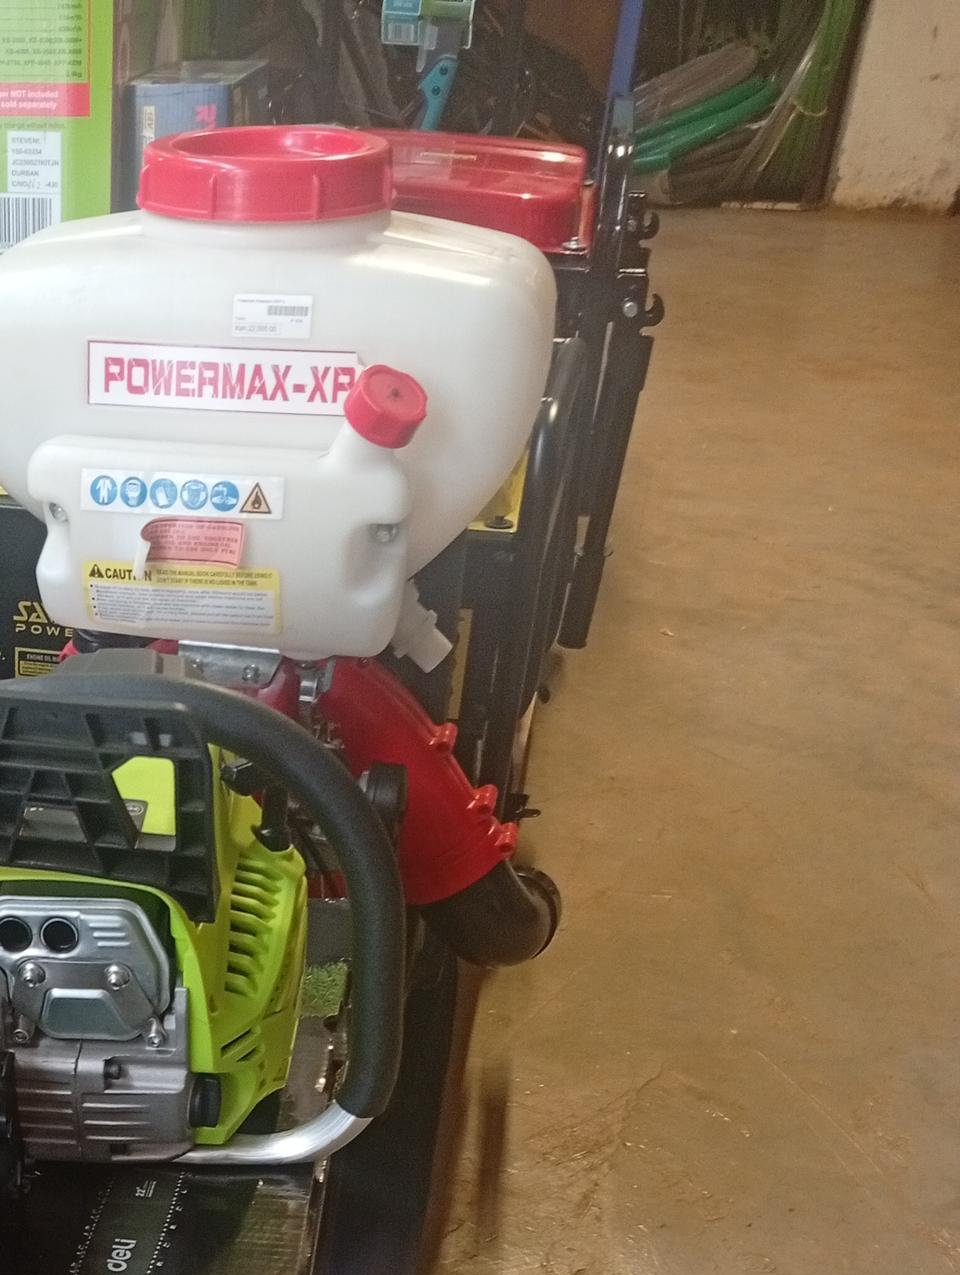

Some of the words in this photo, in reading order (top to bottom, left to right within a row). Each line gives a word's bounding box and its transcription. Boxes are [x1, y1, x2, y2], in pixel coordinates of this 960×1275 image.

[11, 90, 27, 98] NOT
[28, 90, 59, 99] included
[1, 100, 17, 108] sold
[19, 100, 58, 110] separately
[105, 568, 152, 582] CAUTN
[15, 623, 74, 638] POWE
[106, 1238, 137, 1272] deli
